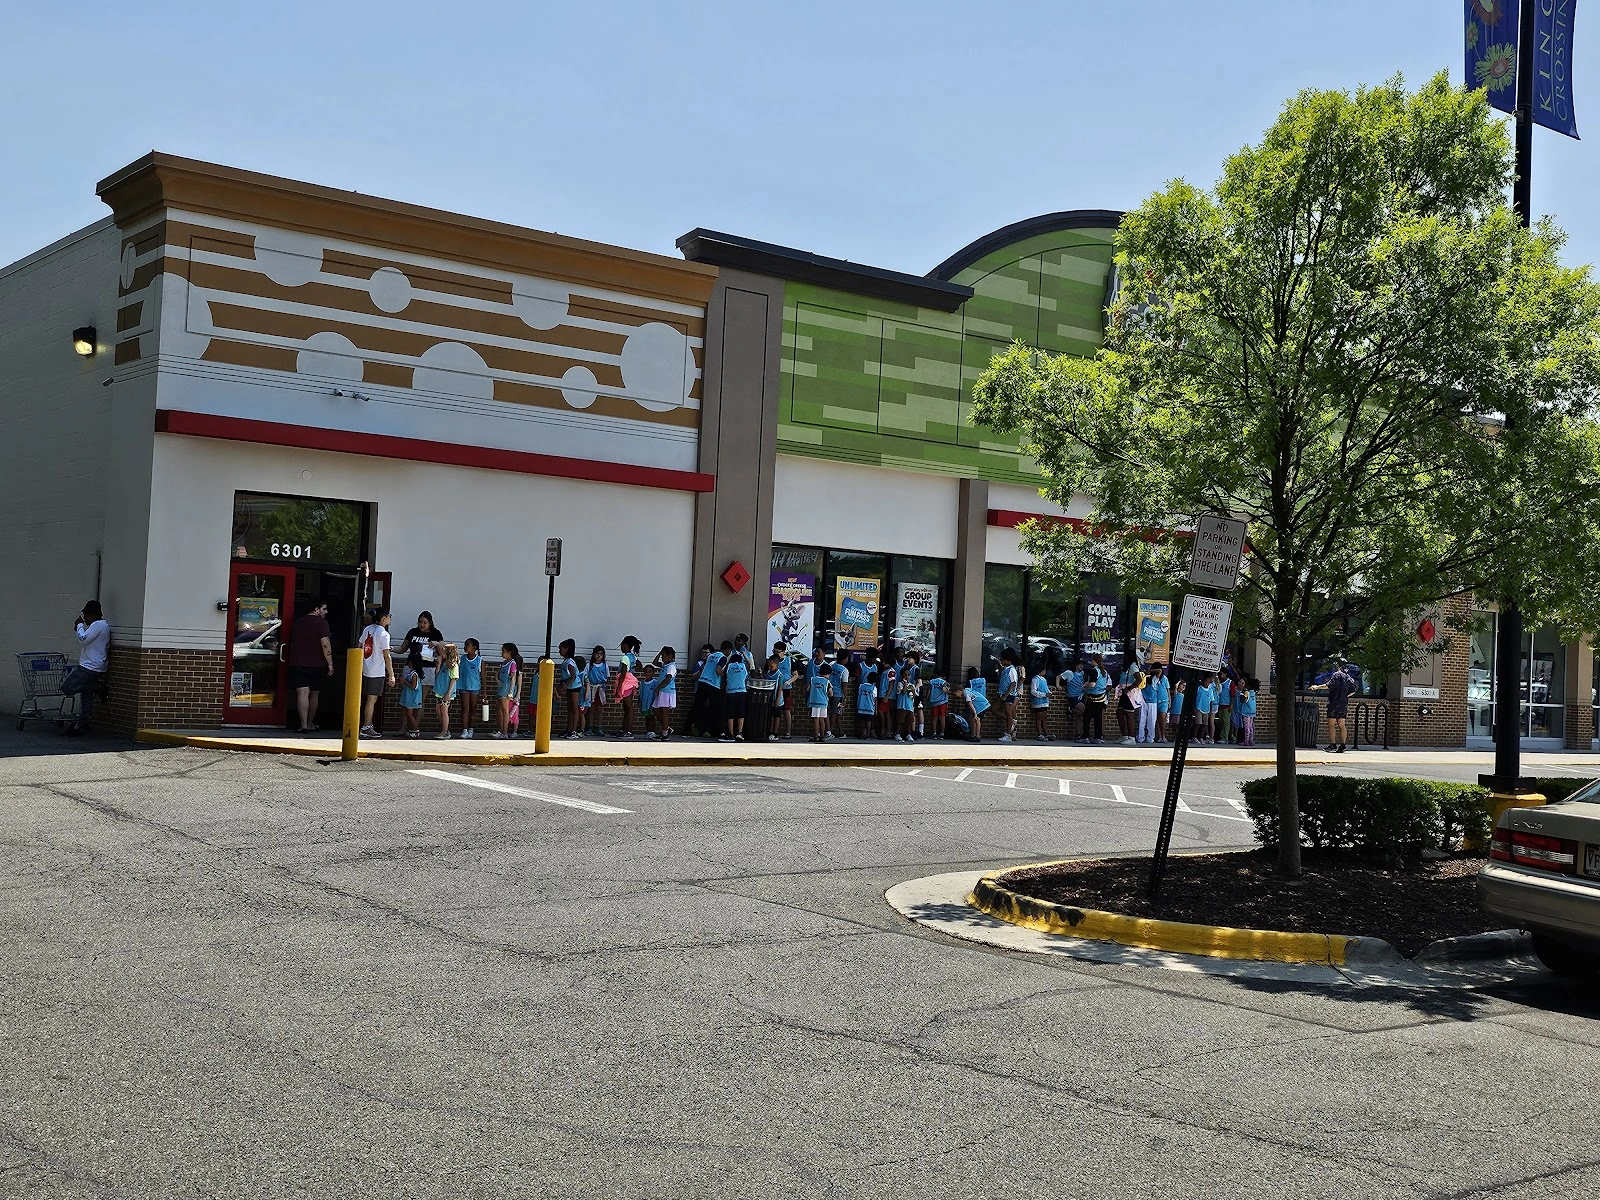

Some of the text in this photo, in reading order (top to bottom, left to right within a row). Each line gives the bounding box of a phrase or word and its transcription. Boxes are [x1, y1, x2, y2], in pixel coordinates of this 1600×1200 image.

[1216, 522, 1228, 532] NO
[1202, 532, 1238, 546] PARKING
[270, 542, 312, 559] 6301
[1196, 548, 1237, 564] STANDING
[1194, 560, 1236, 576] FIRE LANE
[840, 580, 878, 592] UNLIMITED
[904, 592, 932, 600] GROUP
[902, 600, 932, 609] EVENTS
[1088, 604, 1116, 616] COME
[1140, 602, 1169, 612] UNLIMITED
[1192, 600, 1224, 612] CUSTOMER
[1088, 615, 1116, 628] PLAY
[1194, 610, 1220, 621] PARKING
[1190, 618, 1207, 628] WHILE
[410, 636, 430, 644] PINK
[1188, 628, 1217, 640] PREMISES
[1085, 642, 1116, 654] GAMES
